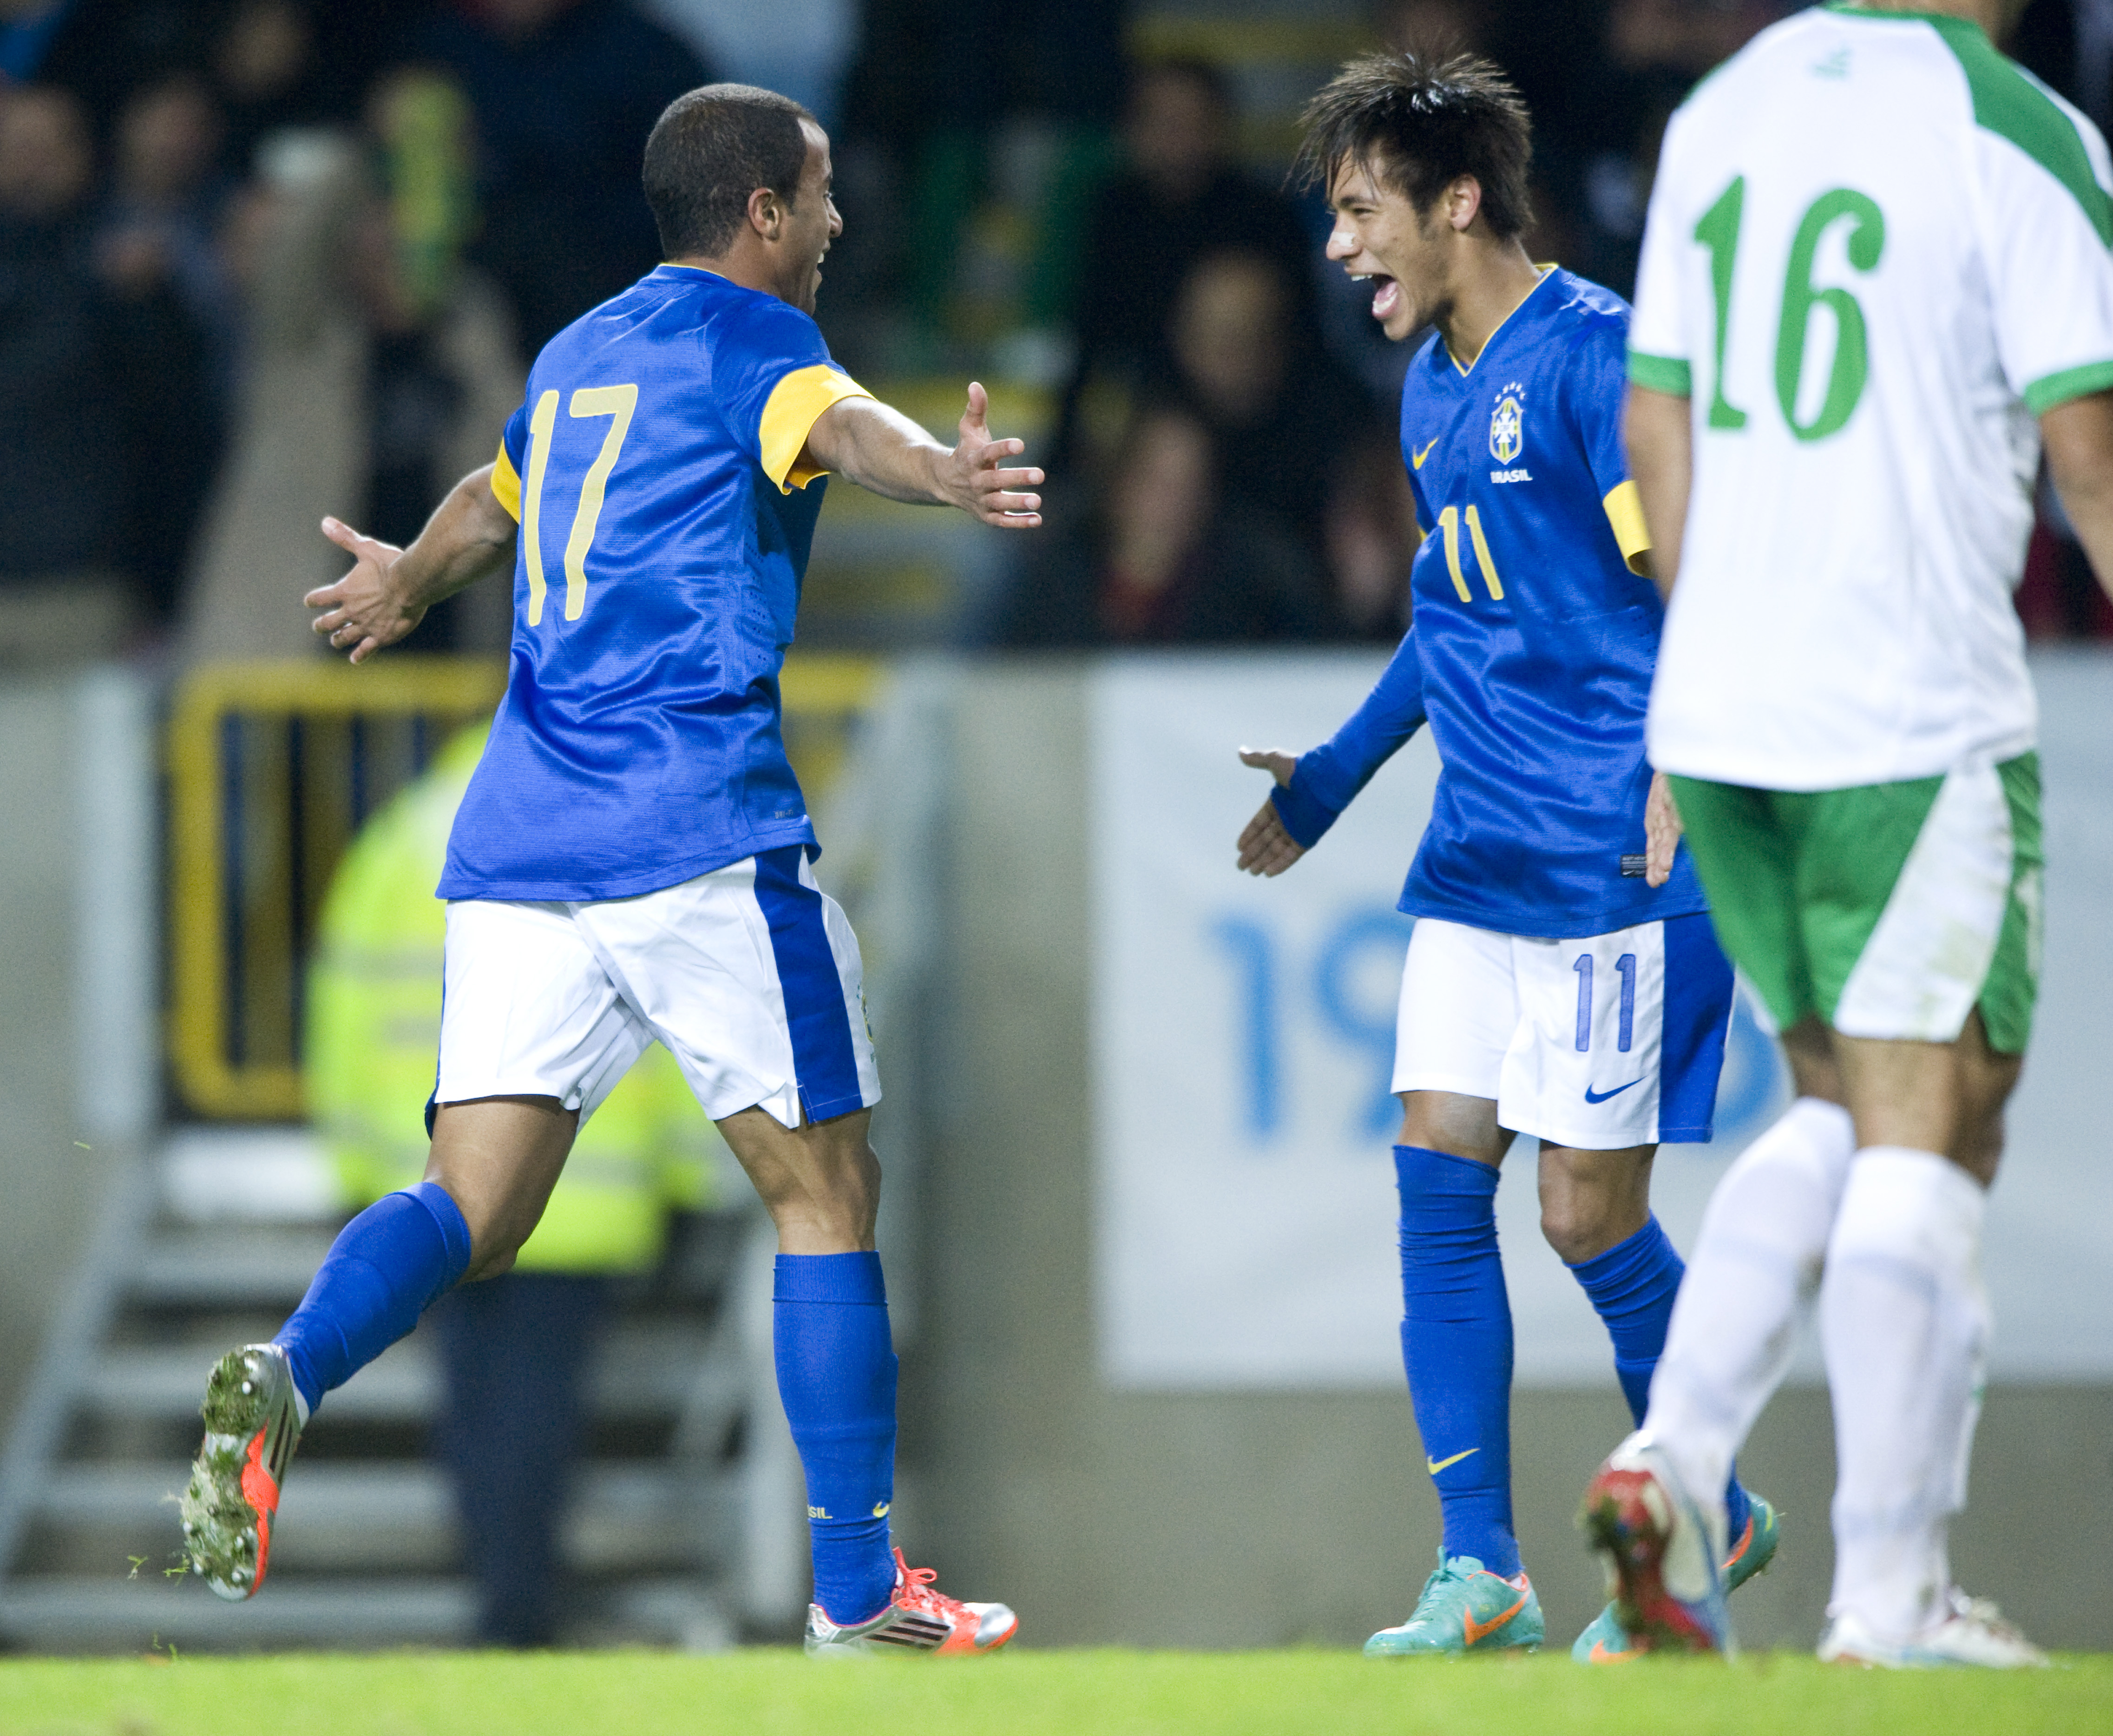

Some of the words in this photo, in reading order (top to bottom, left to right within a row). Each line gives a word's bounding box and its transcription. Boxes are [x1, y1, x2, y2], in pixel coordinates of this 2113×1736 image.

[1694, 175, 1885, 442] 16
[524, 384, 638, 627] 17
[1490, 468, 1533, 484] BRASIL
[1438, 505, 1504, 603] 11
[1573, 954, 1636, 1052] 11
[807, 1505, 833, 1519] SIL
